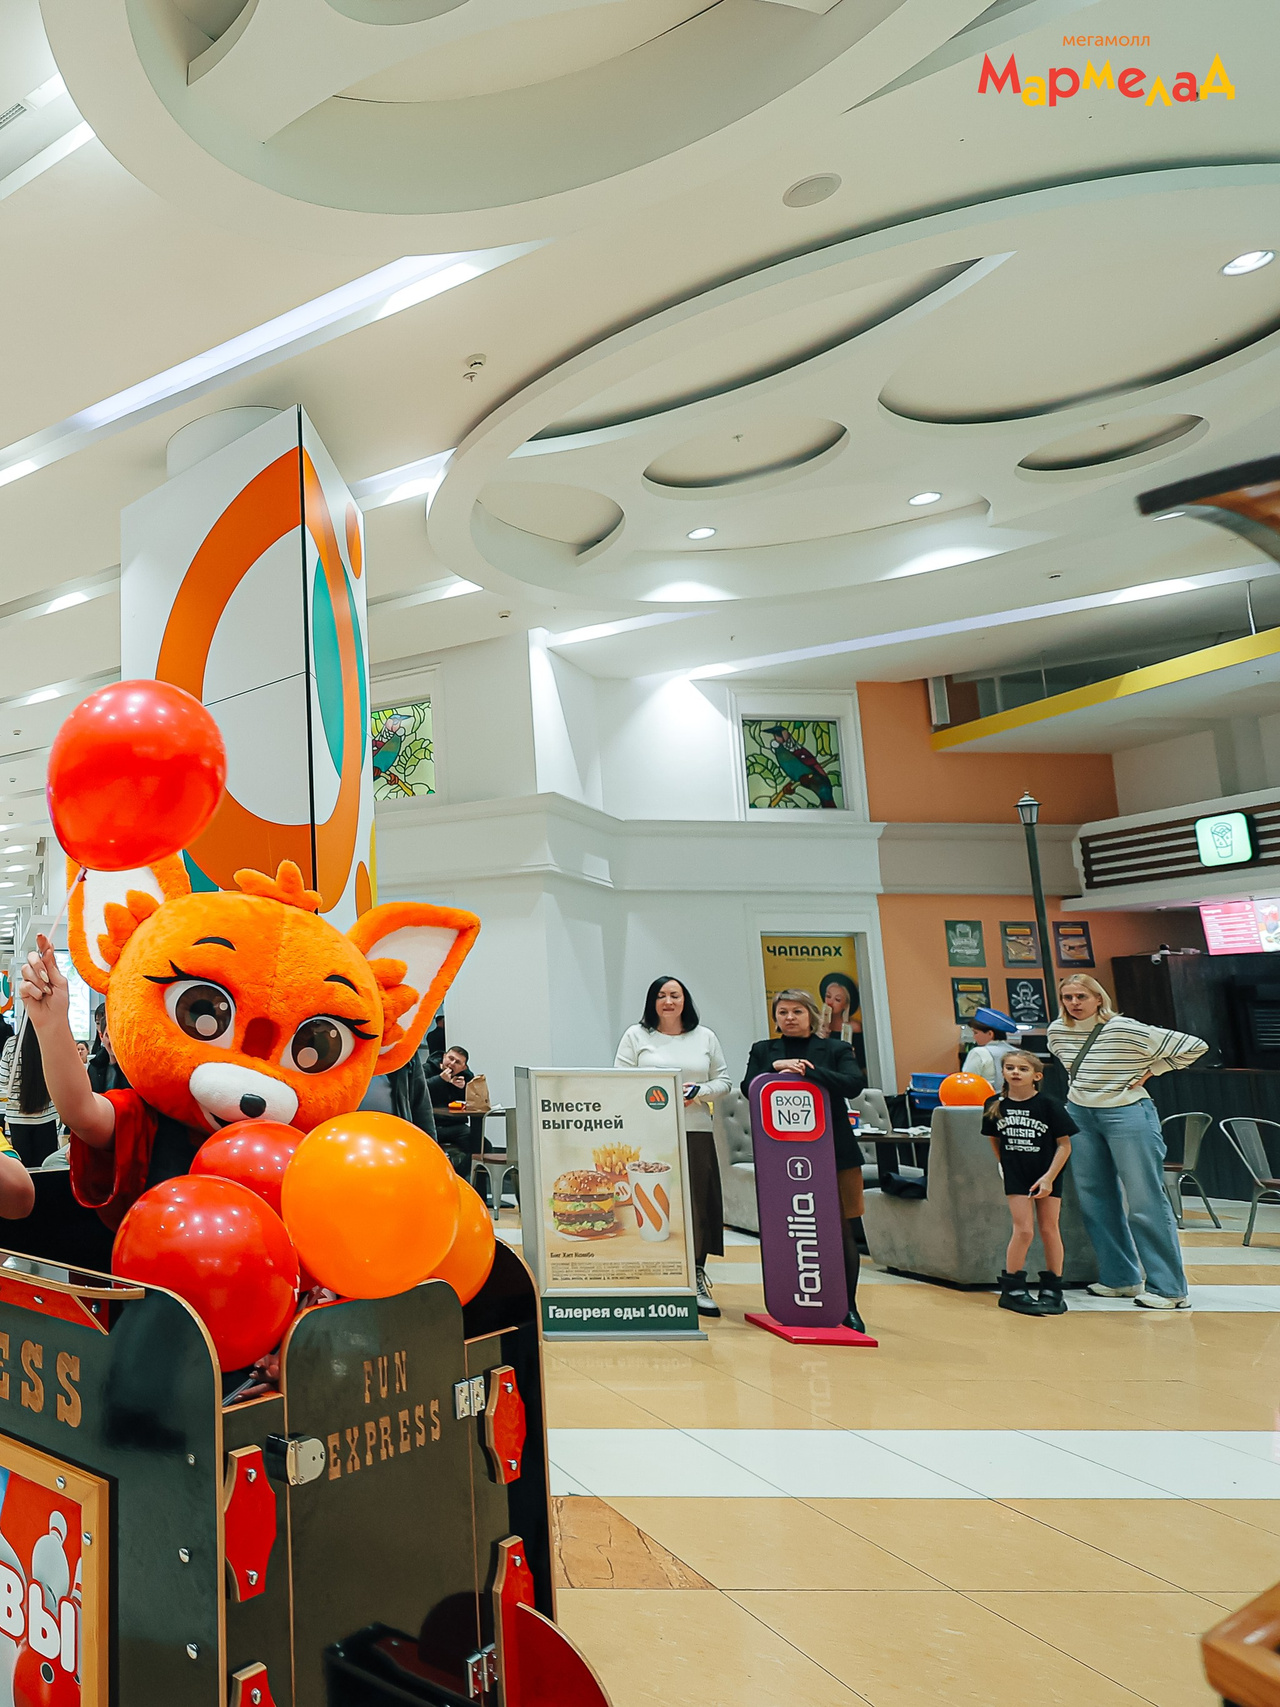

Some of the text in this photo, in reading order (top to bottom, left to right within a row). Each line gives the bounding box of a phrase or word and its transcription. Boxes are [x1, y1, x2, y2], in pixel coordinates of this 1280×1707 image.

[766, 944, 843, 957] ЧАПАЛАХ
[541, 1098, 602, 1115] Вместе
[775, 1095, 812, 1109] ВХОД
[542, 1114, 624, 1132] выгодней
[777, 1109, 811, 1127] №7
[788, 1191, 823, 1308] familia
[548, 1303, 689, 1322] Галерея еды 100м
[362, 1349, 408, 1404] FUN
[327, 1399, 442, 1481] EXPRESS
